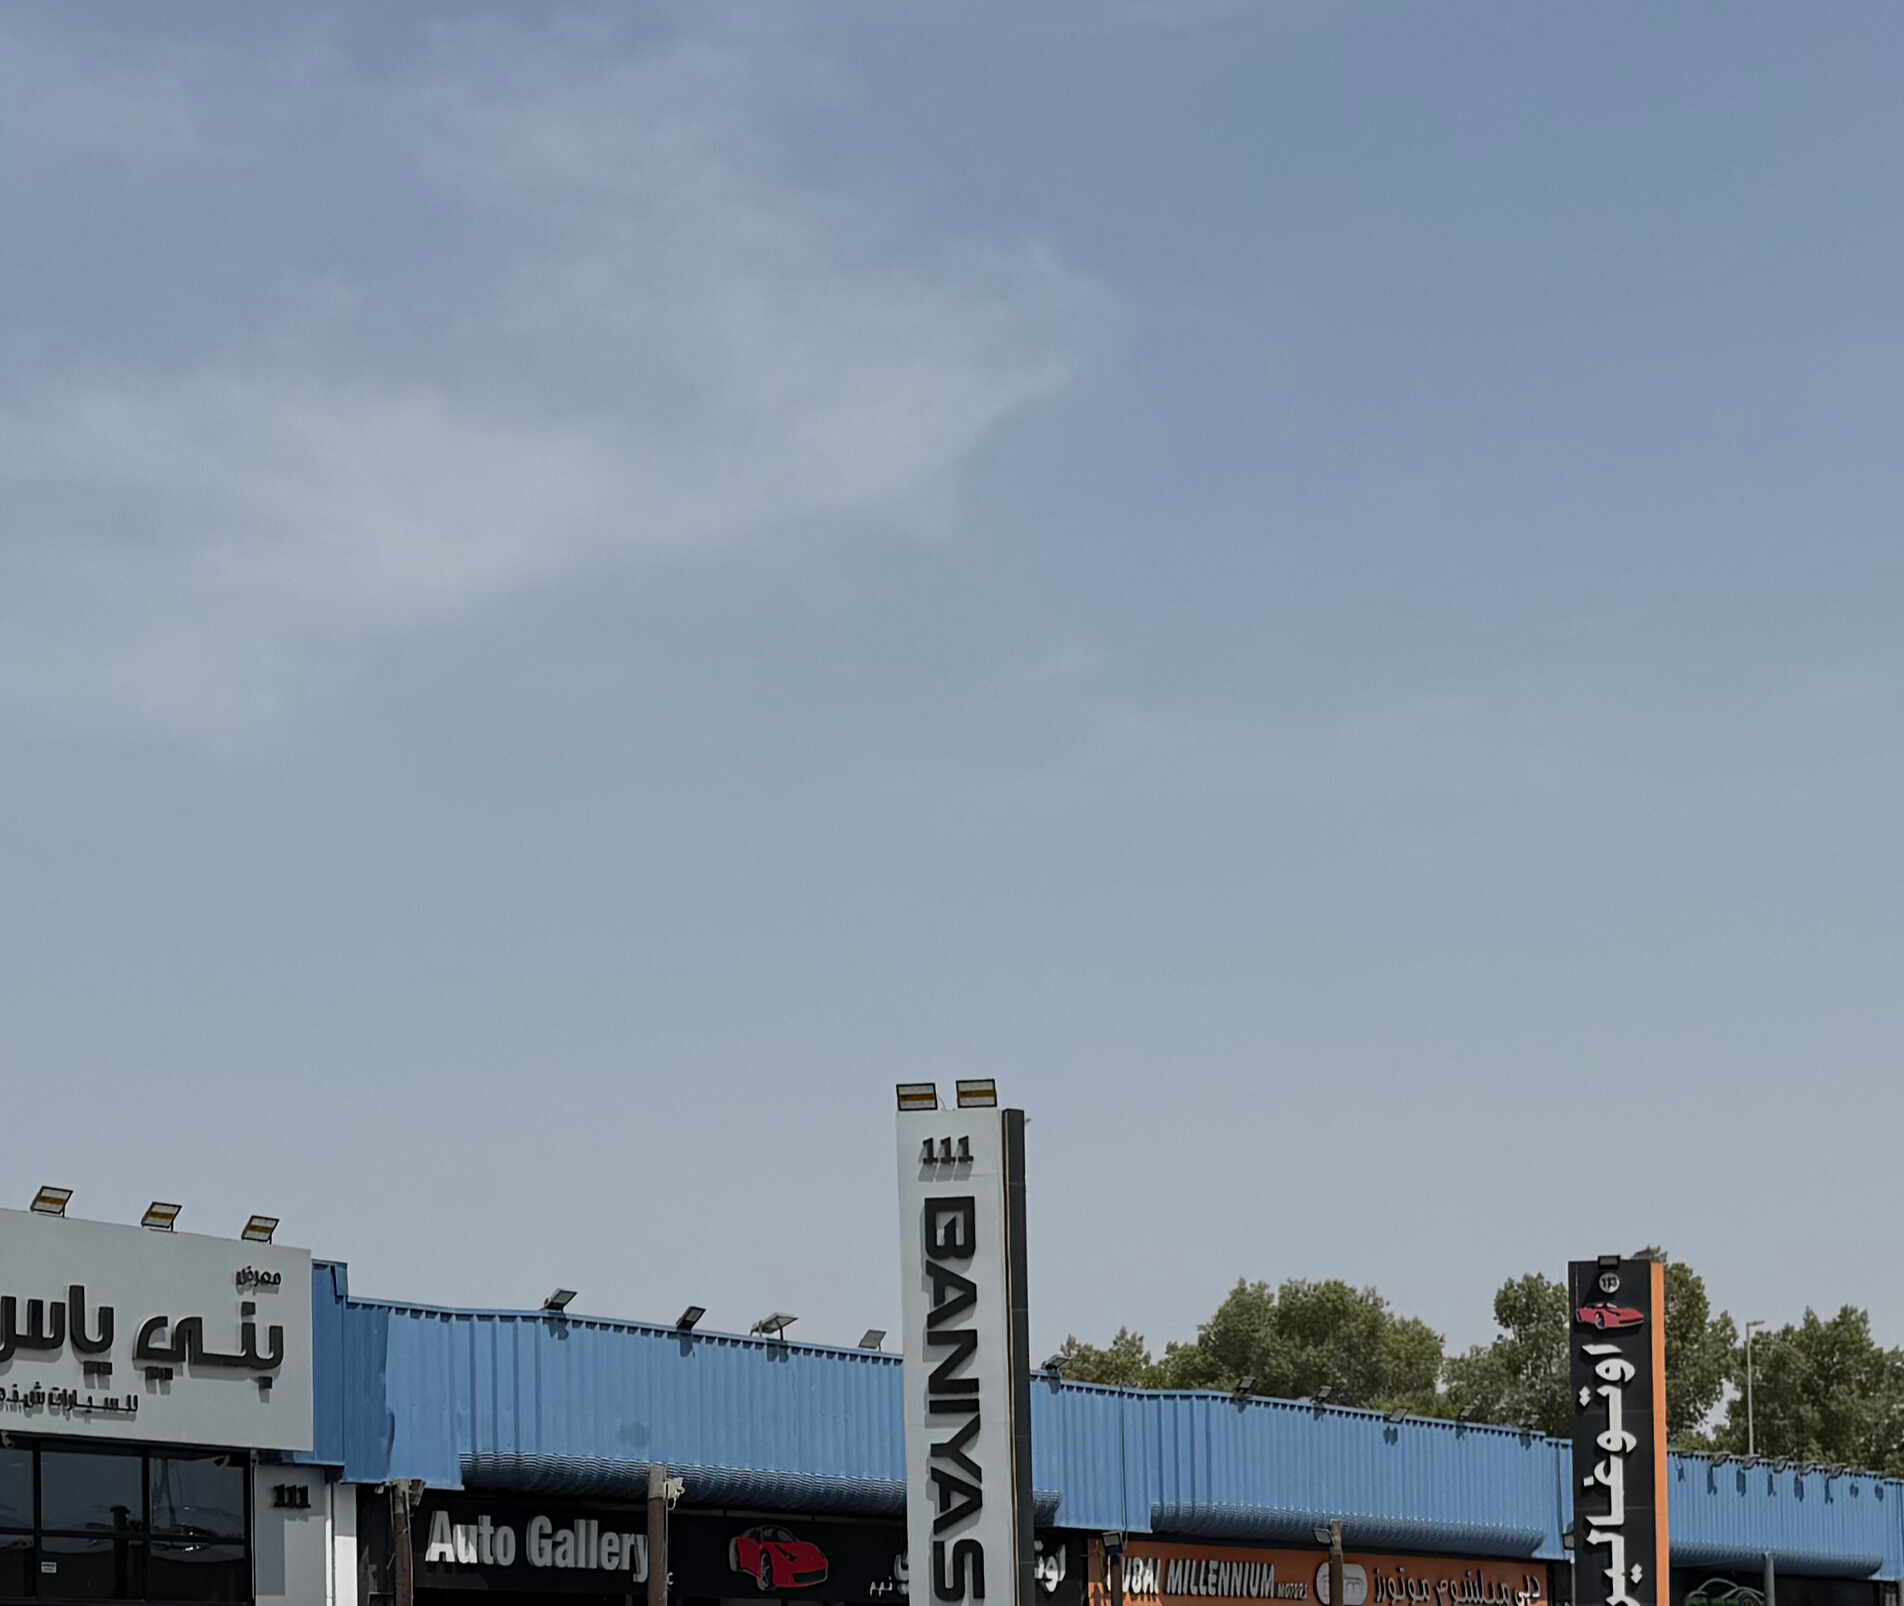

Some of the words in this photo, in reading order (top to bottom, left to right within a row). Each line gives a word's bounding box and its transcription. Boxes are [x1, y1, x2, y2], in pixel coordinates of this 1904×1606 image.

[921, 1136, 974, 1165] 111
[136, 1300, 284, 1390] بني
[924, 1195, 985, 1601] BANIYAS
[272, 1483, 310, 1509] 111
[424, 1510, 517, 1567] Auto
[525, 1514, 648, 1583] Gallery
[1107, 1555, 1161, 1594] UBAI
[1167, 1559, 1275, 1598] MILLENNIUM
